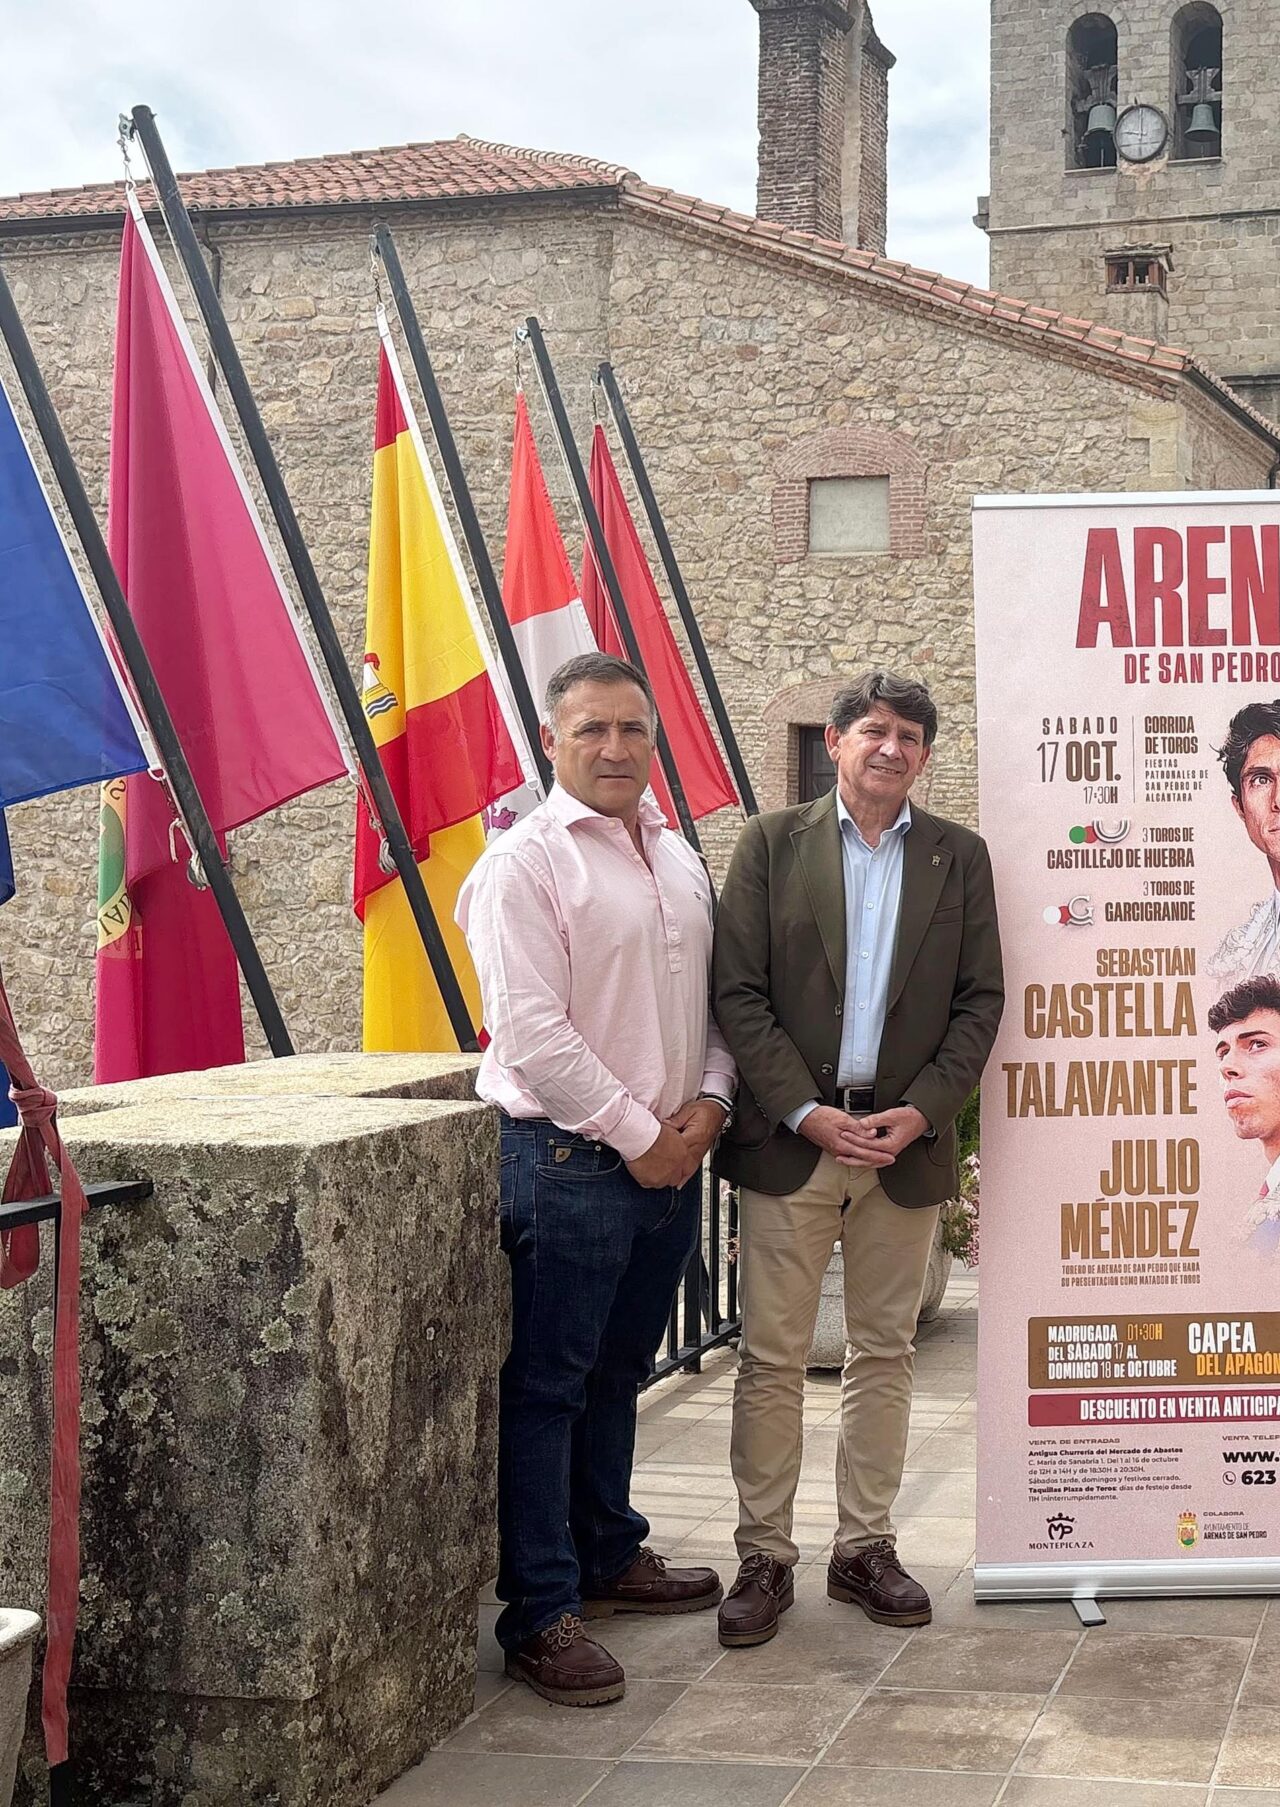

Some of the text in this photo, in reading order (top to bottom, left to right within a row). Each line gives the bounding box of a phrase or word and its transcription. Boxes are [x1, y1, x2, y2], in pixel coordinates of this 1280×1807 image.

[1124, 653, 1150, 684] DE
[1158, 652, 1205, 684] SAN
[1144, 715, 1195, 734] CORRIDA
[1145, 736, 1198, 754] DE TOROS
[1036, 740, 1122, 783] 17 OCT.
[1145, 758, 1178, 768] FIESTAS
[1145, 769, 1209, 779] PATRONALES DE
[1083, 786, 1118, 804] 17:30H
[1145, 781, 1202, 791] SAN PEDRO DE
[1142, 827, 1194, 843] 3 TOROS DE
[1047, 848, 1195, 870] CASTILLEJO DE HUEBRA
[1143, 881, 1195, 896] 3 TOROS DE
[1105, 901, 1195, 922] GARCIGRANDE
[1096, 945, 1196, 977] SEBASTIÁN
[1023, 982, 1198, 1040] CASTELLA
[1002, 1060, 1198, 1118] TALAVANTE
[1100, 1138, 1201, 1197] JULIO
[1060, 1198, 1201, 1260] MÉNDEZ
[1061, 1264, 1086, 1274] TORERO
[1087, 1264, 1095, 1274] DE
[1096, 1264, 1122, 1274] ARENAS
[1123, 1263, 1131, 1273] DE
[1132, 1263, 1146, 1273] SAN
[1147, 1262, 1168, 1272] PEDRO
[1169, 1262, 1181, 1273] QUE
[1061, 1277, 1070, 1287] SU
[1120, 1276, 1138, 1285] COMO
[1139, 1275, 1169, 1285] MATADOR
[1170, 1275, 1178, 1284] DE
[1180, 1274, 1200, 1284] TOROS
[1048, 1323, 1163, 1343] MADRUGADA 01:30H
[1188, 1322, 1257, 1354] CAPEA
[1048, 1342, 1138, 1361] DEL SÁBADO 17 AL
[1048, 1359, 1177, 1380] DOMINGO 18 DE OCTUBRE
[1196, 1354, 1221, 1376] DEL
[1080, 1398, 1157, 1420] DESCUENTO
[1160, 1397, 1176, 1418] EN
[1178, 1396, 1221, 1418] VENTA
[1028, 1449, 1058, 1458] Antigua
[1109, 1447, 1141, 1455] Mercado
[1081, 1476, 1117, 1484] domingos
[1241, 1470, 1276, 1485] 623
[1028, 1486, 1061, 1494] Taquillas
[1203, 1530, 1267, 1540] ARENAS DE SAN PEDRO
[1028, 1541, 1094, 1550] MONTEPICAZA
